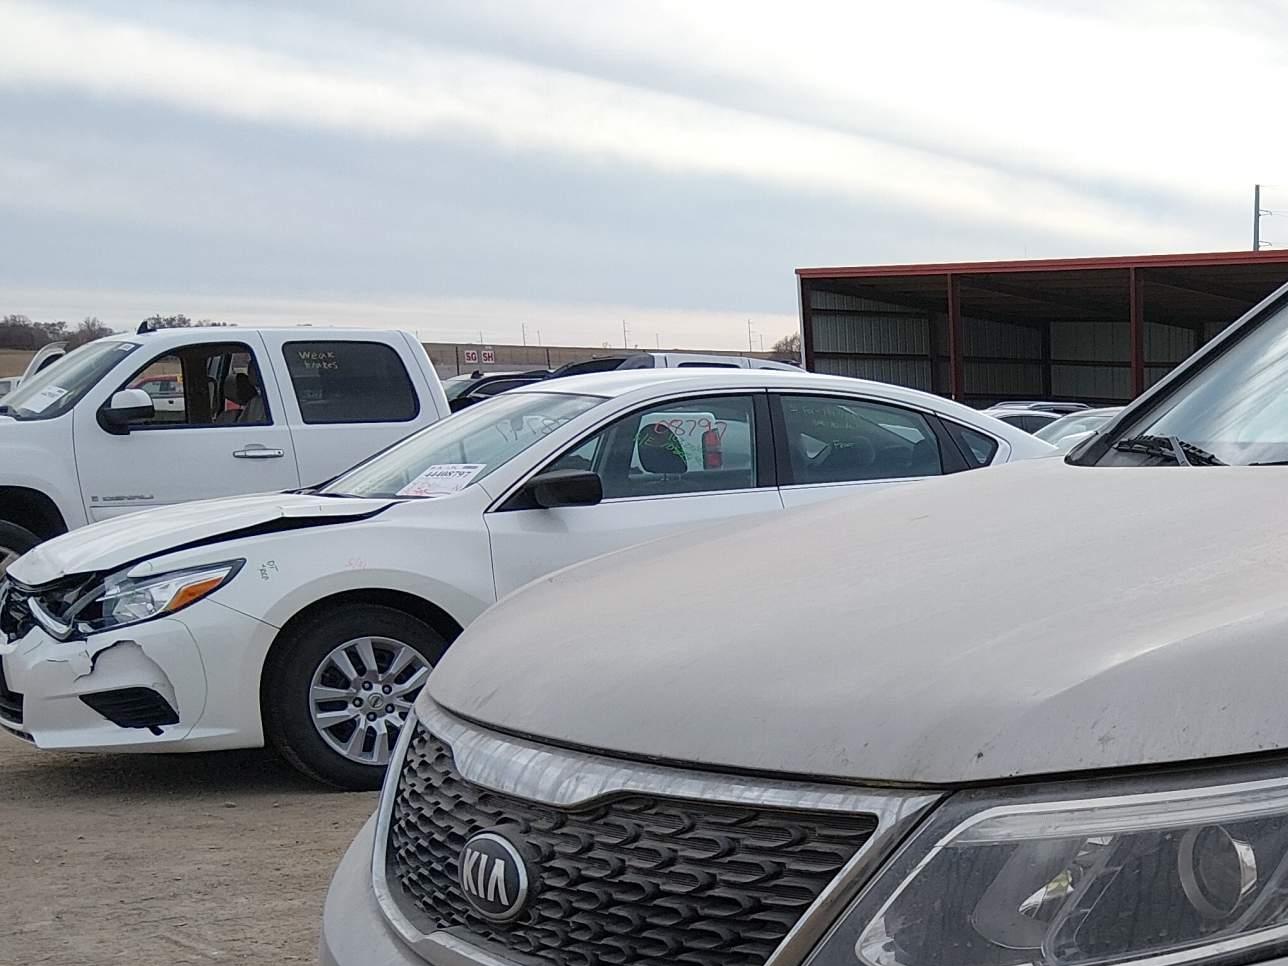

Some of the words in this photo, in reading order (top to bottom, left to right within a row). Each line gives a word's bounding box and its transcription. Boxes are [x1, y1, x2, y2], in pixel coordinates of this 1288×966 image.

[483, 352, 494, 362] SH
[655, 418, 728, 440] 08797
[463, 847, 510, 906] KIA
